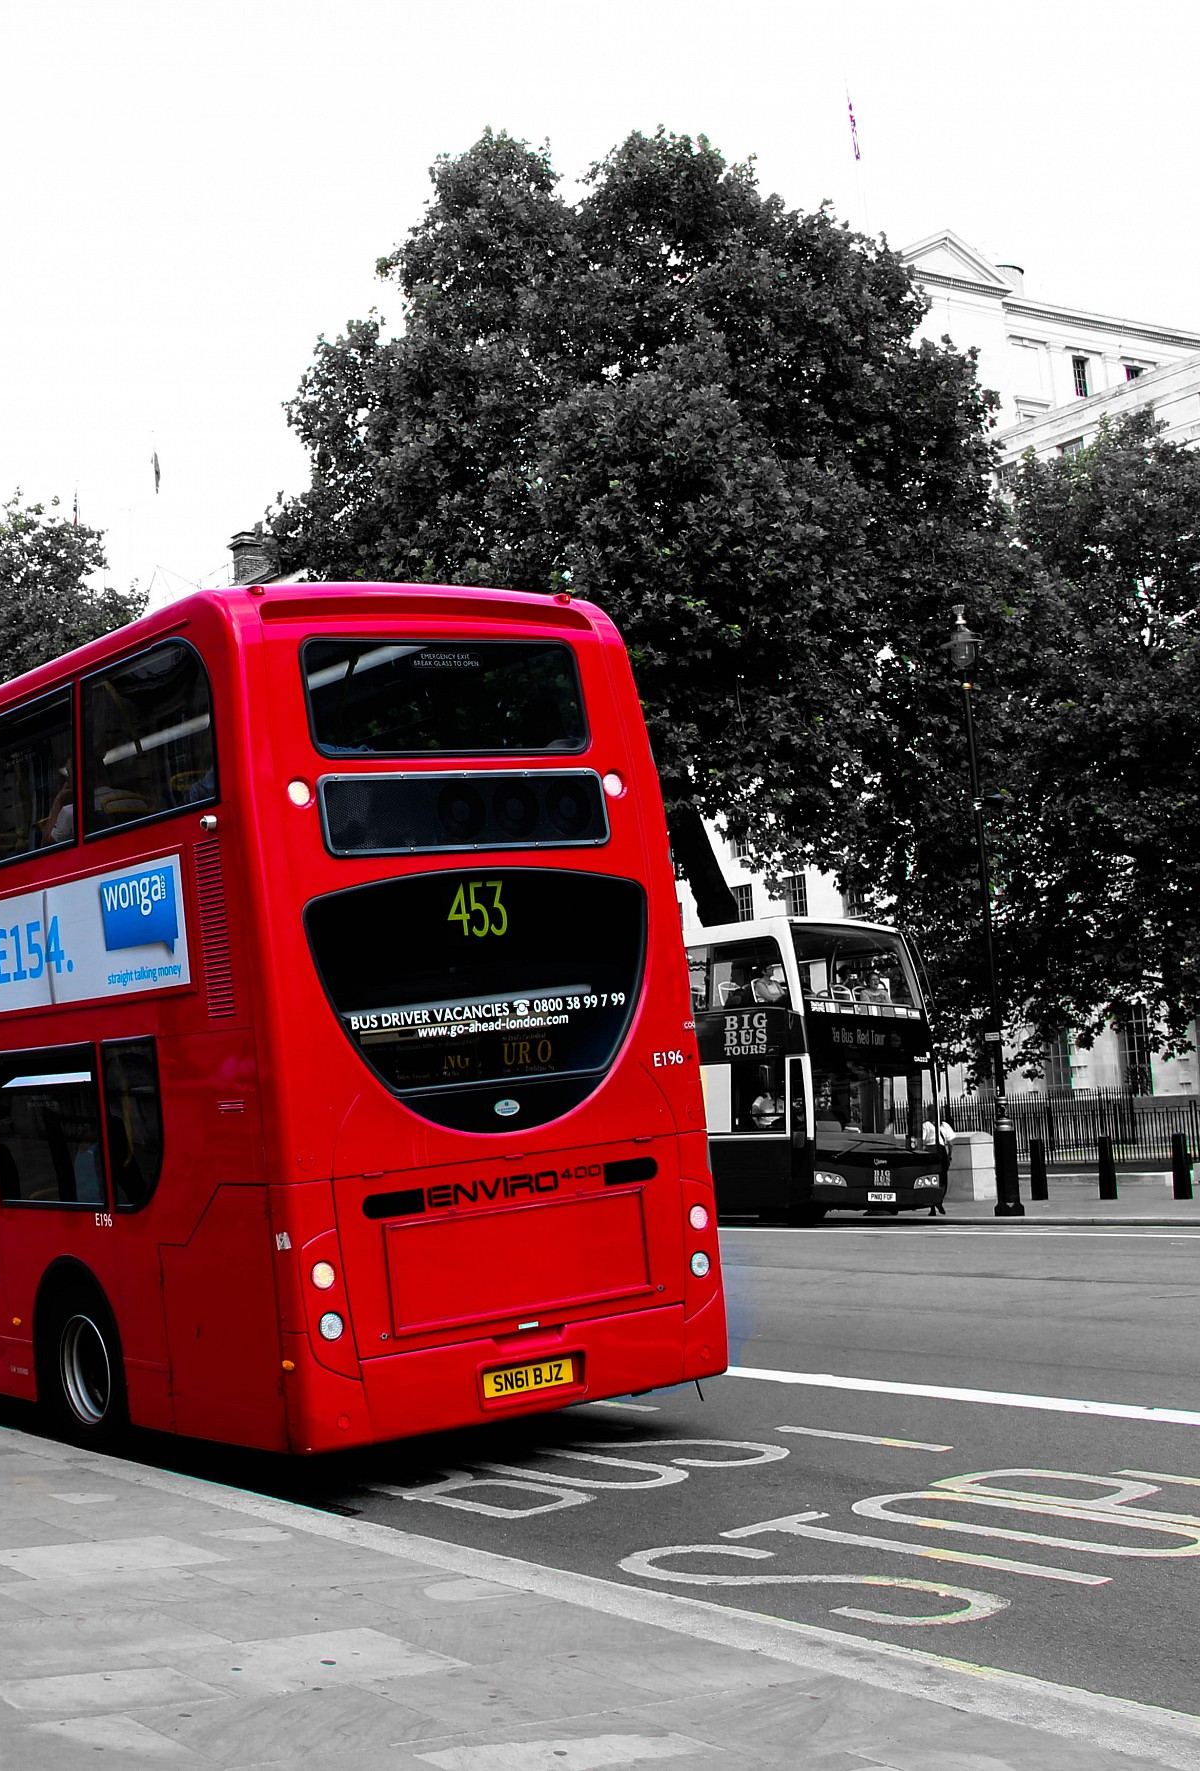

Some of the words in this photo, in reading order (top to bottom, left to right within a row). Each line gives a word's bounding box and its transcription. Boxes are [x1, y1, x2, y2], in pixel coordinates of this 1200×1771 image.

[447, 880, 508, 937] 453
[108, 968, 133, 987] straight
[134, 966, 157, 982] talking
[158, 964, 182, 979] money
[350, 1014, 378, 1030] BUS
[381, 1009, 431, 1027] DRIVER
[433, 1002, 510, 1022] VACANCIES
[533, 998, 563, 1013] 0800
[565, 996, 581, 1010] 38
[583, 994, 598, 1009] 99
[600, 993, 608, 1007] 7
[611, 992, 626, 1006] 99
[724, 1012, 768, 1031] BIG
[417, 1014, 569, 1038] www.go-ahead-london.com
[841, 1027, 854, 1044] Bus
[856, 1028, 870, 1045] Red
[870, 1029, 886, 1046] Tour
[724, 1028, 768, 1046] BUS
[653, 1050, 684, 1067] E196
[724, 1044, 767, 1056] TOURS
[427, 1169, 559, 1209] ENVIRO
[561, 1164, 601, 1180] 400
[95, 1212, 113, 1227] E196
[493, 1369, 530, 1393] SN61
[532, 1362, 564, 1386] BJZ
